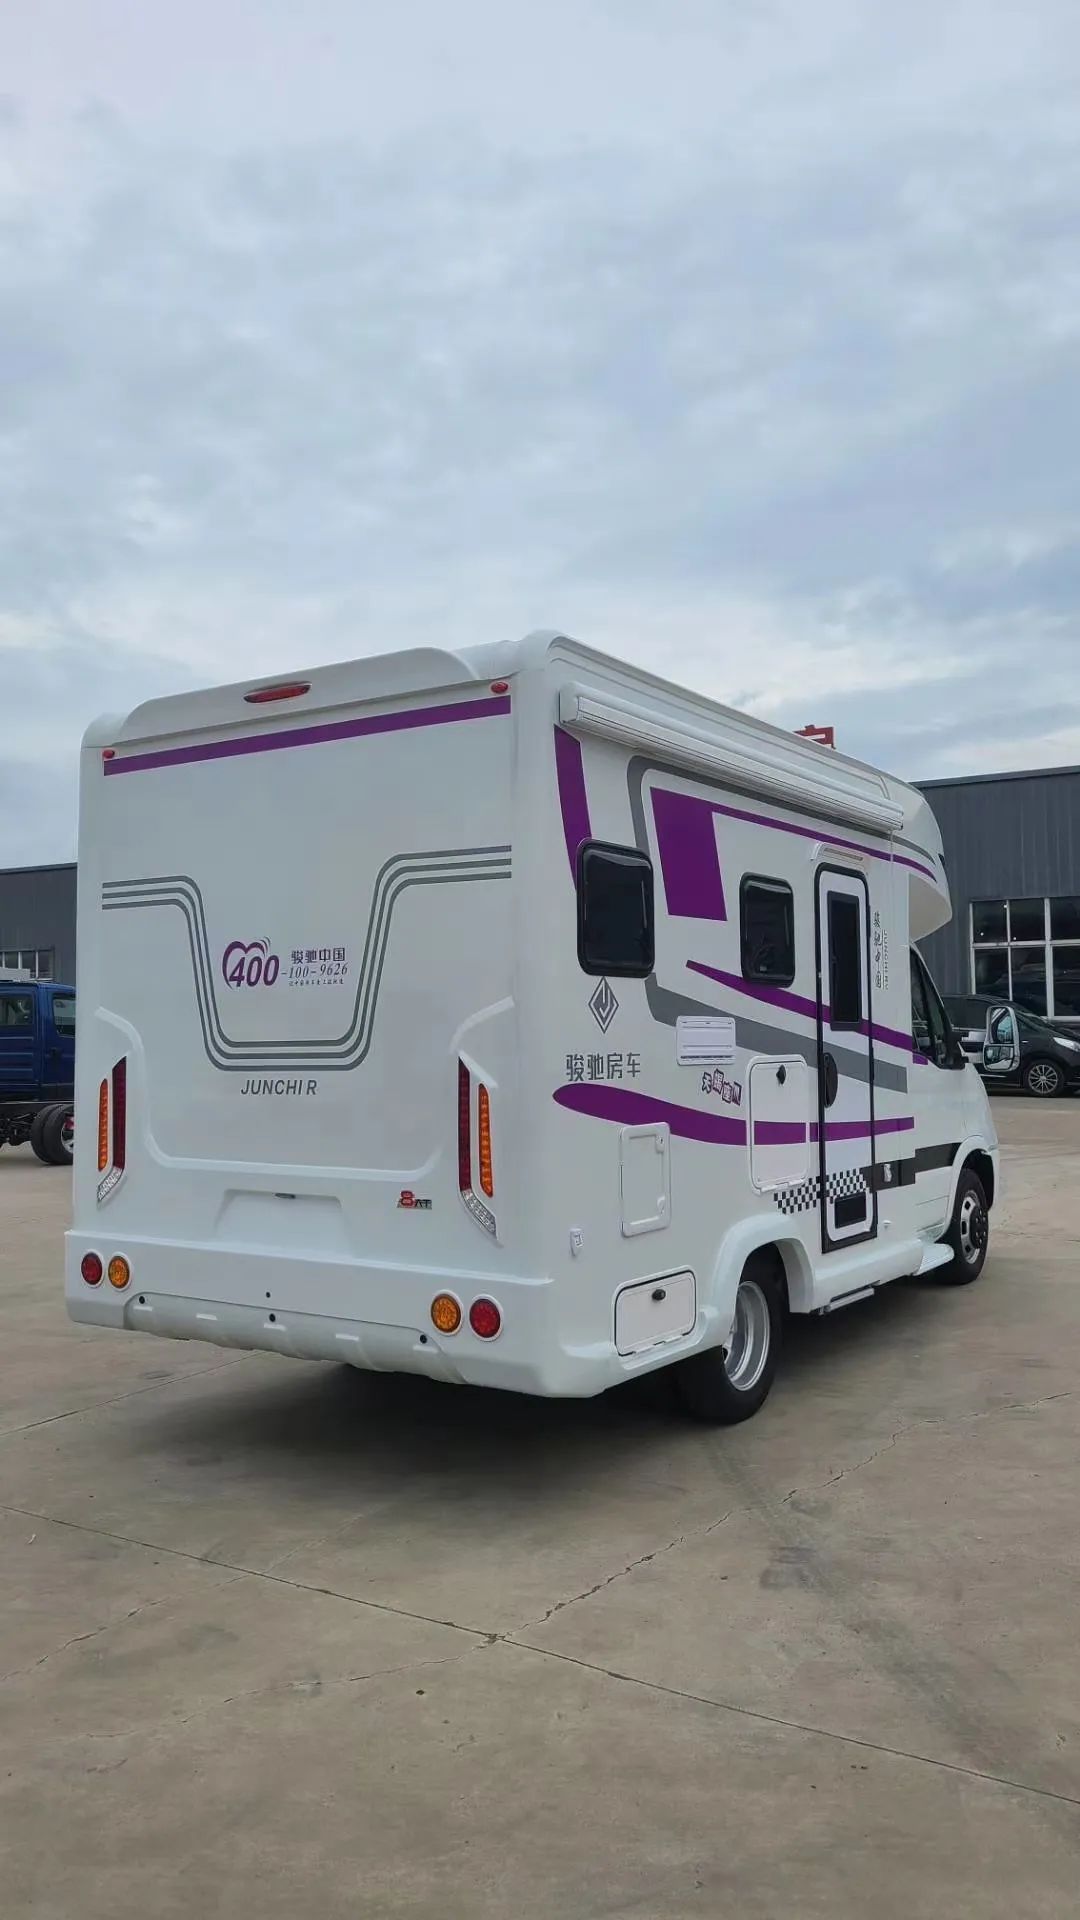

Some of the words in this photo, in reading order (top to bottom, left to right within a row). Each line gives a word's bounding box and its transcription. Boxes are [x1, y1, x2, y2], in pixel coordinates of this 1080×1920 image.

[291, 947, 345, 964] 骏驰中国
[565, 1052, 641, 1082] 骏驰房车
